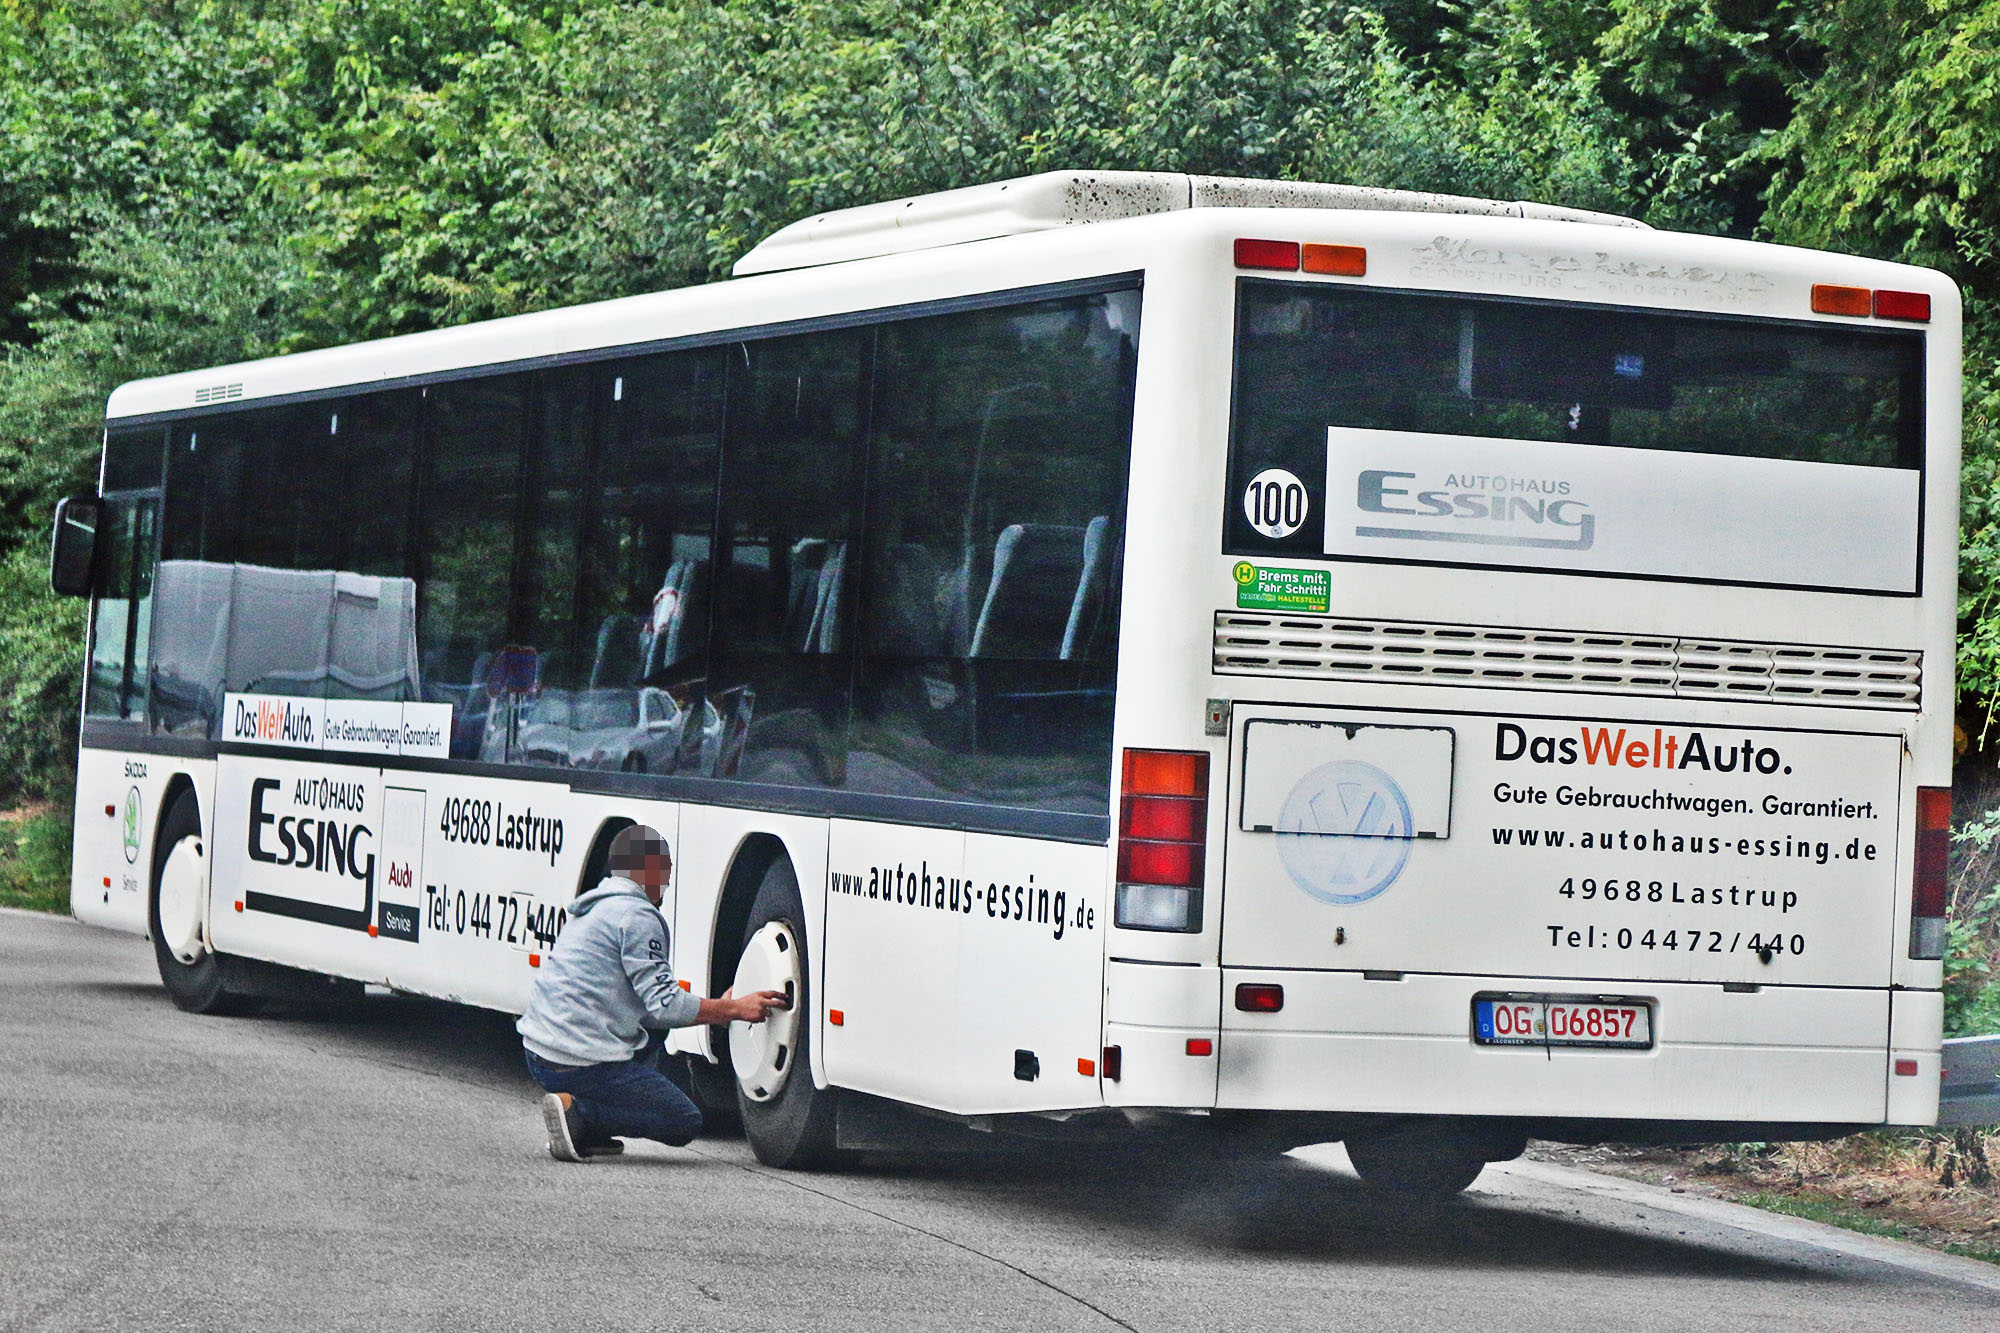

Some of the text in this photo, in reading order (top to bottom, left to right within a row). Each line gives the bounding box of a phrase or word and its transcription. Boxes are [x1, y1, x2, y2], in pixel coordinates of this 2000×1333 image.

[1445, 473, 1570, 495] AUTOHAUS
[1249, 481, 1302, 527] 100
[1239, 567, 1328, 585] H Brems mit.
[1258, 582, 1327, 596] Fahr Schritt!
[1278, 594, 1326, 604] HALTESTELLE
[234, 698, 442, 750] DasWeltAuto. Gute Gebrauchtwagen. Garantiert.
[1495, 722, 1793, 776] DasWeltAuto.
[294, 776, 365, 813] AUTOHAUS
[1493, 782, 1878, 820] Gute Gebrauchtwagen. Garantiert.
[440, 797, 563, 867] 49688 Lastrup
[1492, 827, 1877, 865] www.autohaus-essing.de
[388, 861, 412, 888] Audi
[426, 884, 451, 932] Tel:
[831, 860, 1095, 941] www.autohaus-essing.de
[1558, 877, 1797, 913] 49688 Lastrup
[385, 911, 412, 933] Service
[1482, 1023, 1490, 1032] D
[1495, 1005, 1637, 1038] OG 06857
